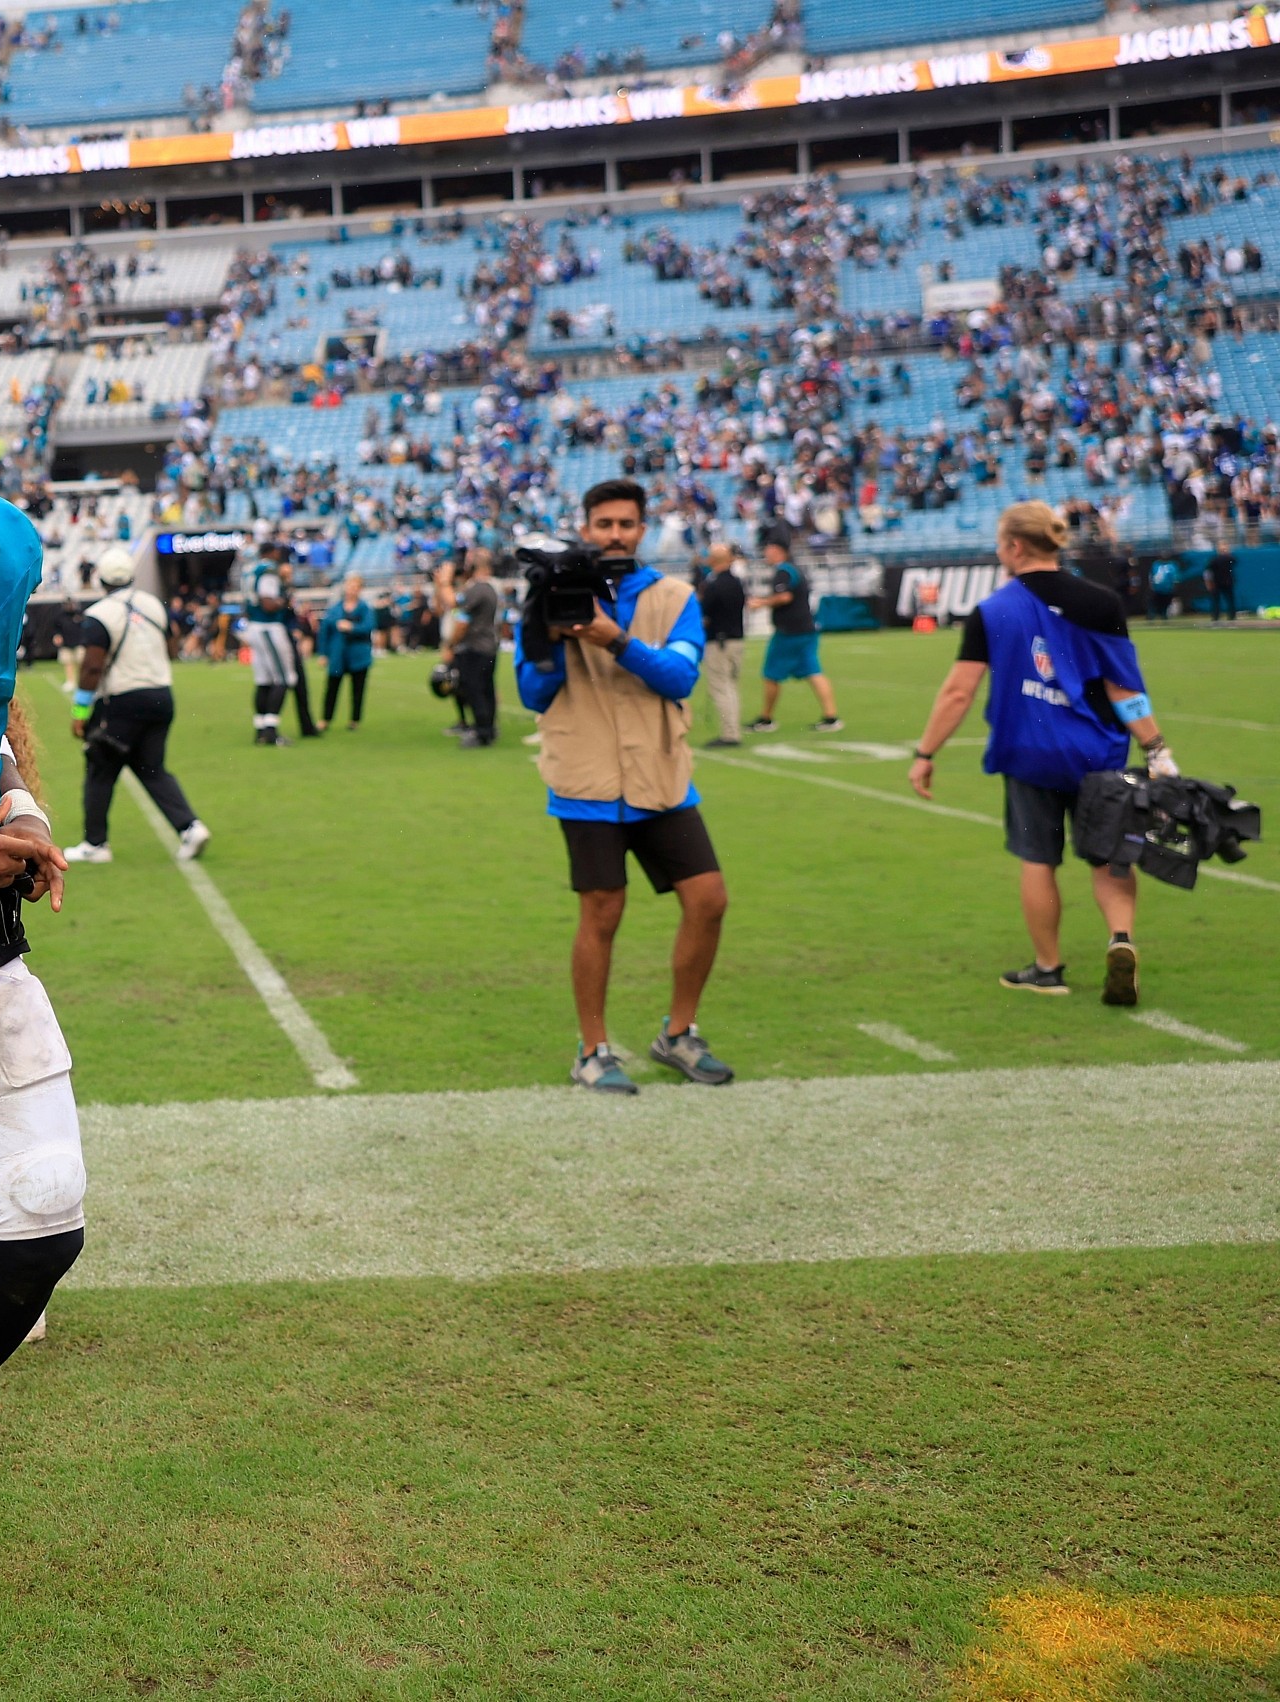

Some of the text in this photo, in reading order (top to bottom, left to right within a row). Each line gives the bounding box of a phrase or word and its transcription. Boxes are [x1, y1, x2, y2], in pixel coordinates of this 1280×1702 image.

[1115, 18, 1251, 66] JAGUARS
[796, 52, 990, 104] JAGUARS WIN
[505, 86, 684, 134] JAGUARS WIN
[77, 139, 130, 171] WIN
[230, 116, 401, 159] JAGUARS WIN
